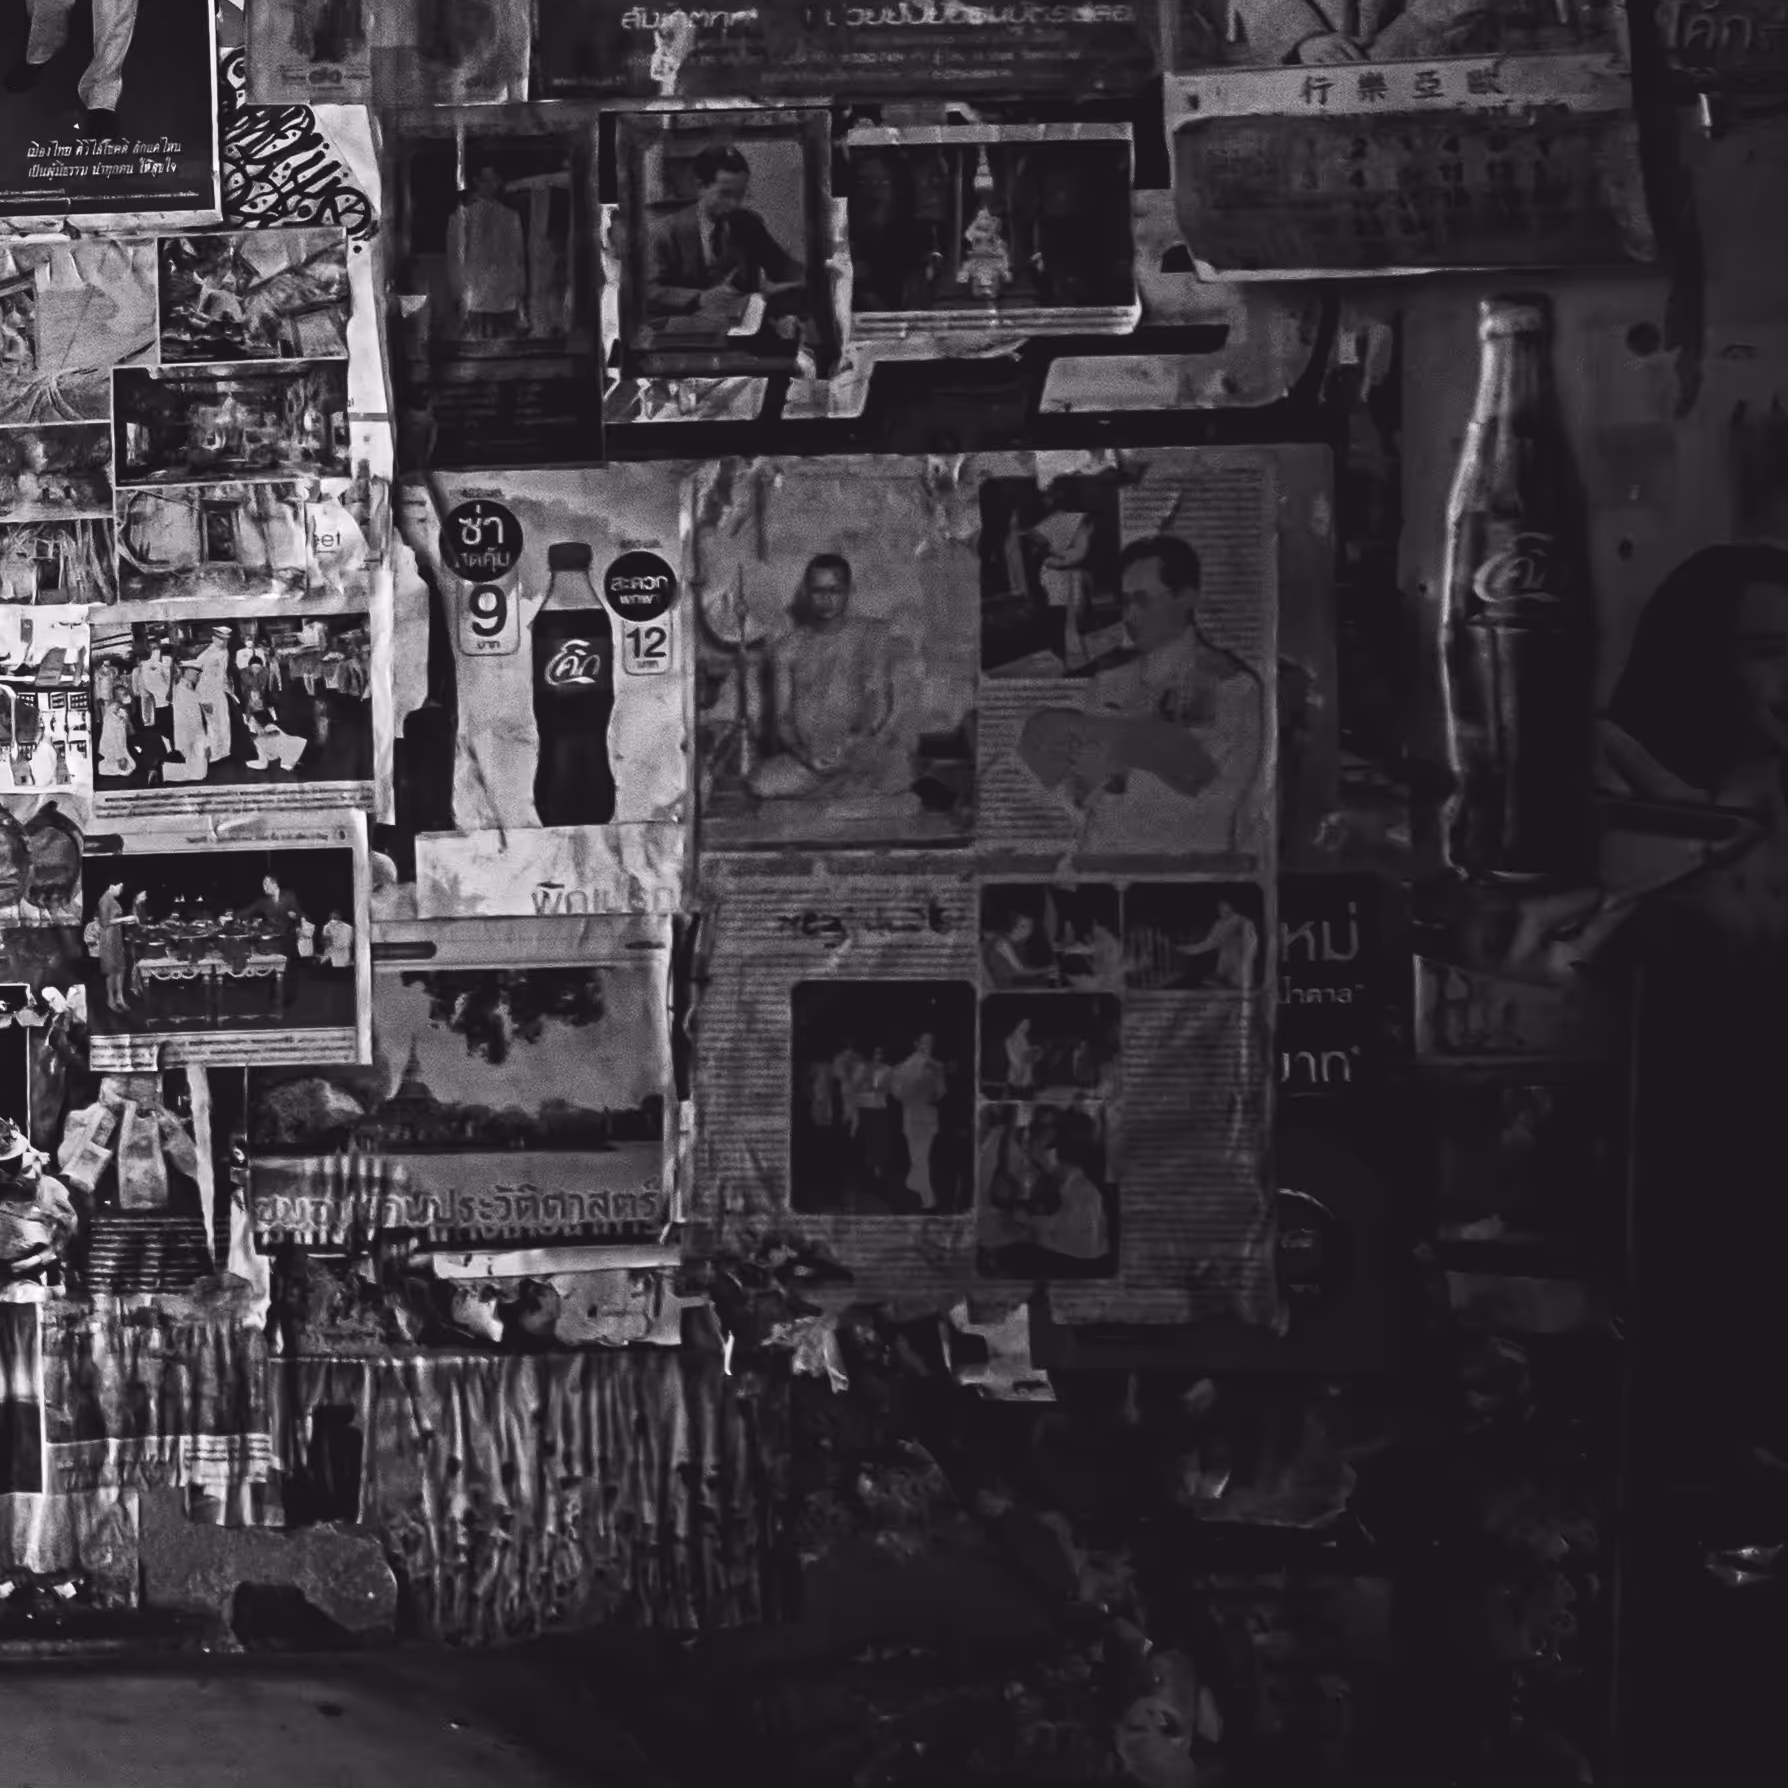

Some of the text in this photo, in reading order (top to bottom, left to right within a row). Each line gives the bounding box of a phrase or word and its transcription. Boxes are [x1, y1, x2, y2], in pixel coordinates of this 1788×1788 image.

[458, 504, 505, 545] ซ่า
[469, 584, 508, 637] 9
[626, 626, 667, 658] 12
